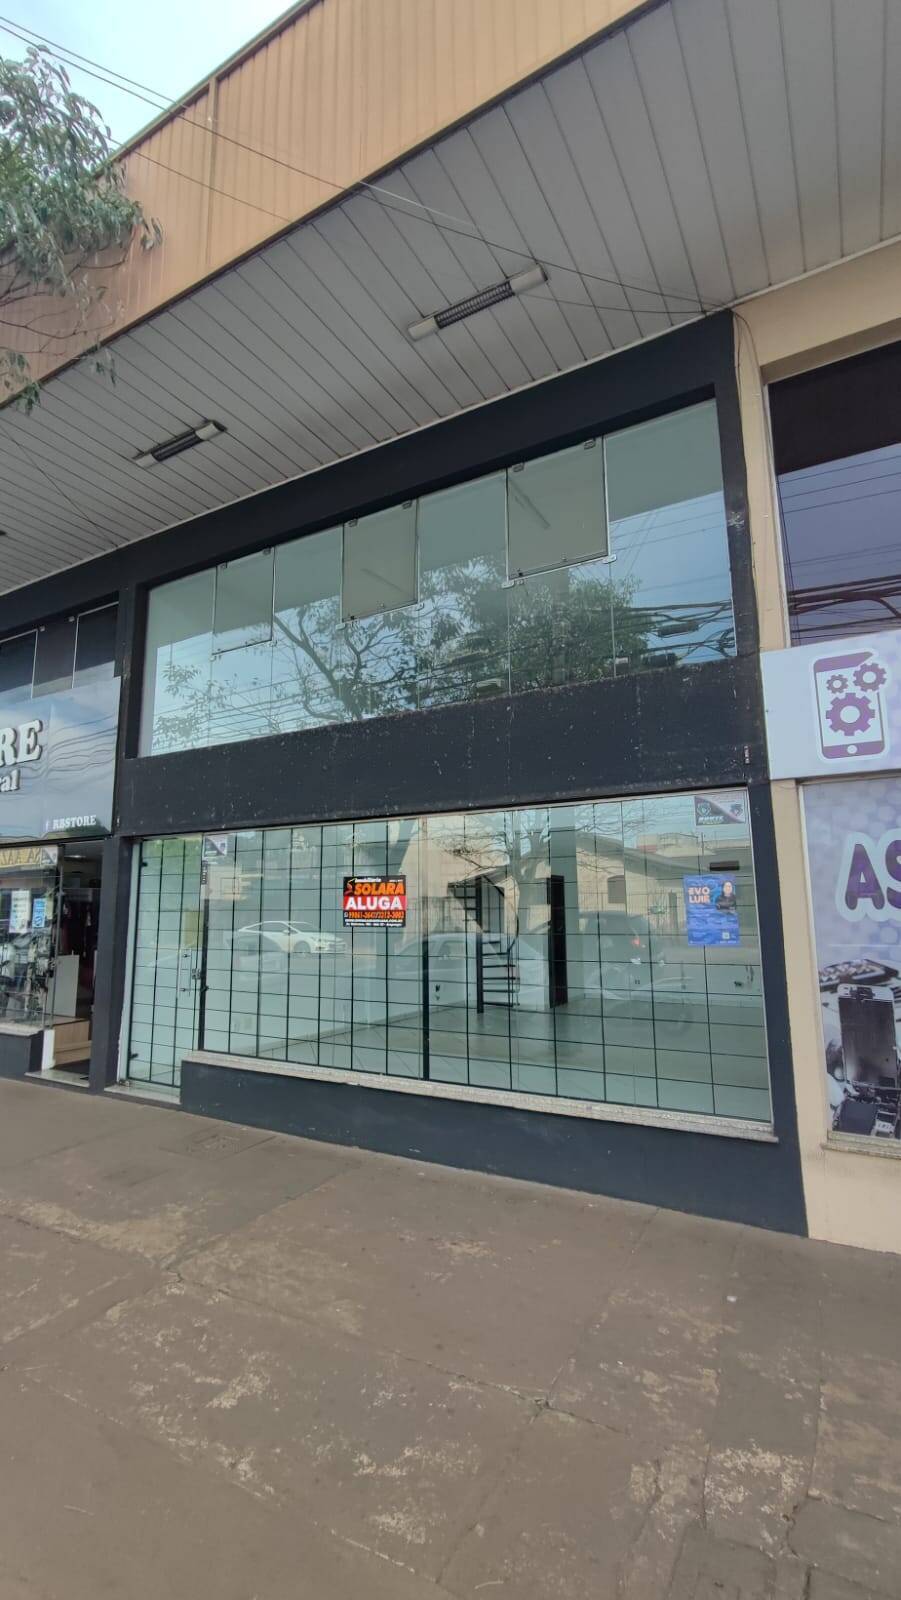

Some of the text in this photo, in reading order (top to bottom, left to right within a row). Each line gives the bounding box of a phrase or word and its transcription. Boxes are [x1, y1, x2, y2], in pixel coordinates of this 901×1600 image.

[354, 882, 405, 895] SOLARA
[688, 886, 710, 896] EVO
[345, 896, 404, 910] ALUGA
